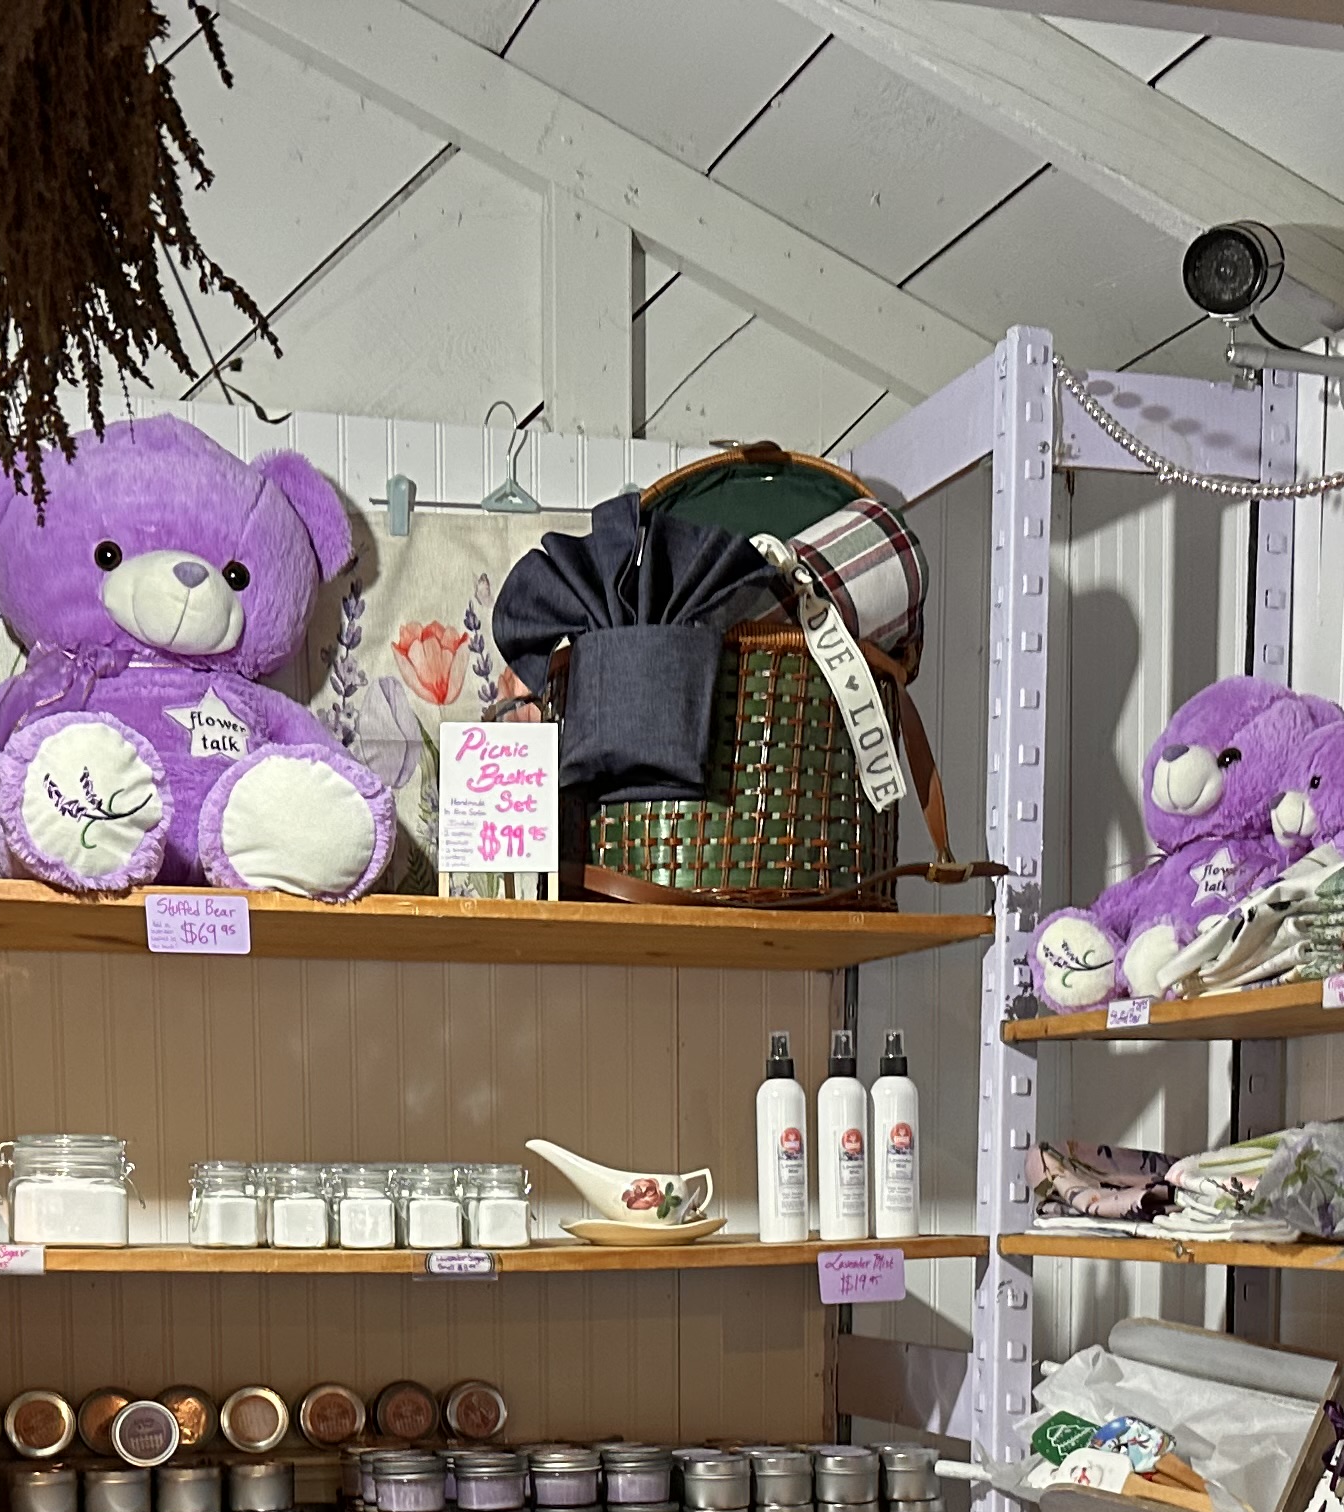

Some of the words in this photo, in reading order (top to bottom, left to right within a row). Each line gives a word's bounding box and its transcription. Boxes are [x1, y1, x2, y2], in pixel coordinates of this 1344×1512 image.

[190, 711, 246, 733] flower
[202, 734, 241, 752] talk
[455, 727, 529, 761] Picnic
[848, 698, 899, 802] LOVE
[466, 763, 548, 793] Basket
[495, 790, 538, 812] Set
[156, 897, 200, 917] Stuffed
[206, 898, 236, 918] Bear
[824, 1254, 869, 1271] Lavender
